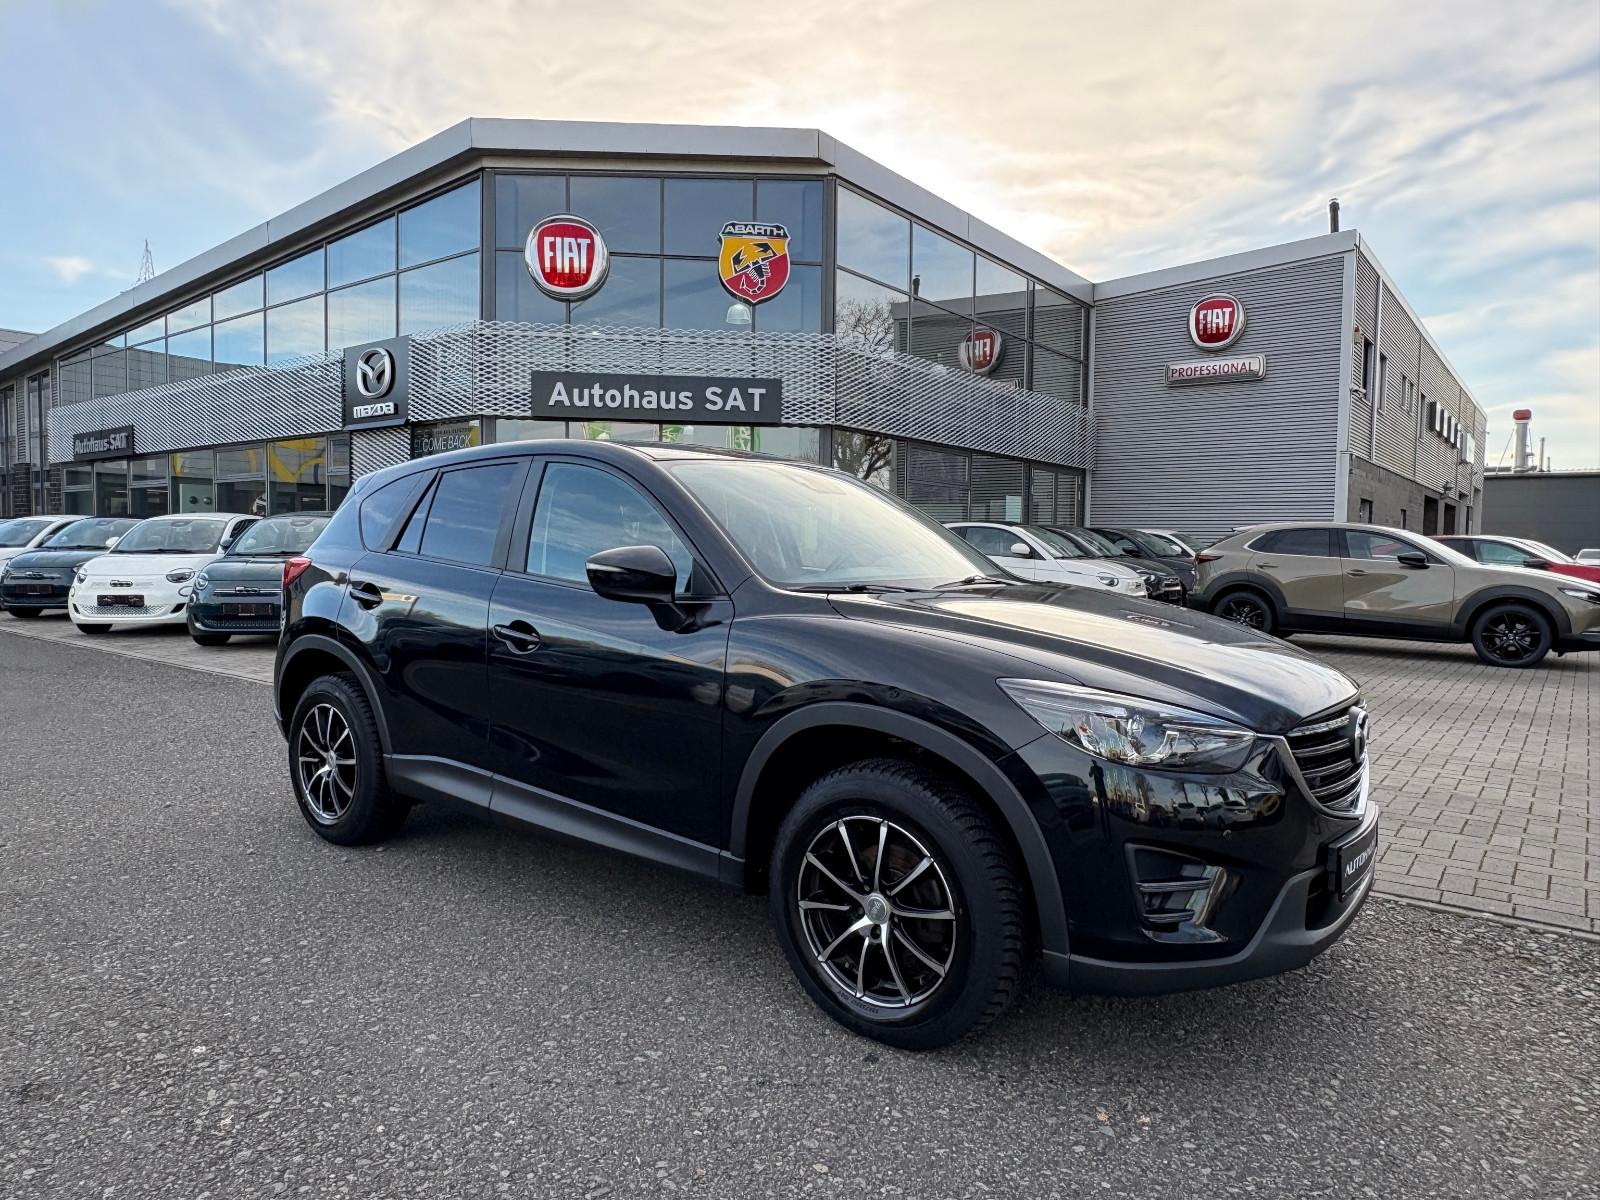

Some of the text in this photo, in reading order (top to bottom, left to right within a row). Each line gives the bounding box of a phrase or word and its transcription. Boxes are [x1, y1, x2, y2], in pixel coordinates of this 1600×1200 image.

[724, 224, 784, 236] ABARTH
[543, 236, 591, 275] FIAT
[1199, 307, 1233, 335] FIAT
[1171, 361, 1255, 378] PROFESSIONAL
[548, 381, 767, 412] Autohaus SAT
[74, 432, 128, 455] Autohaus SAT
[447, 433, 472, 449] BACK
